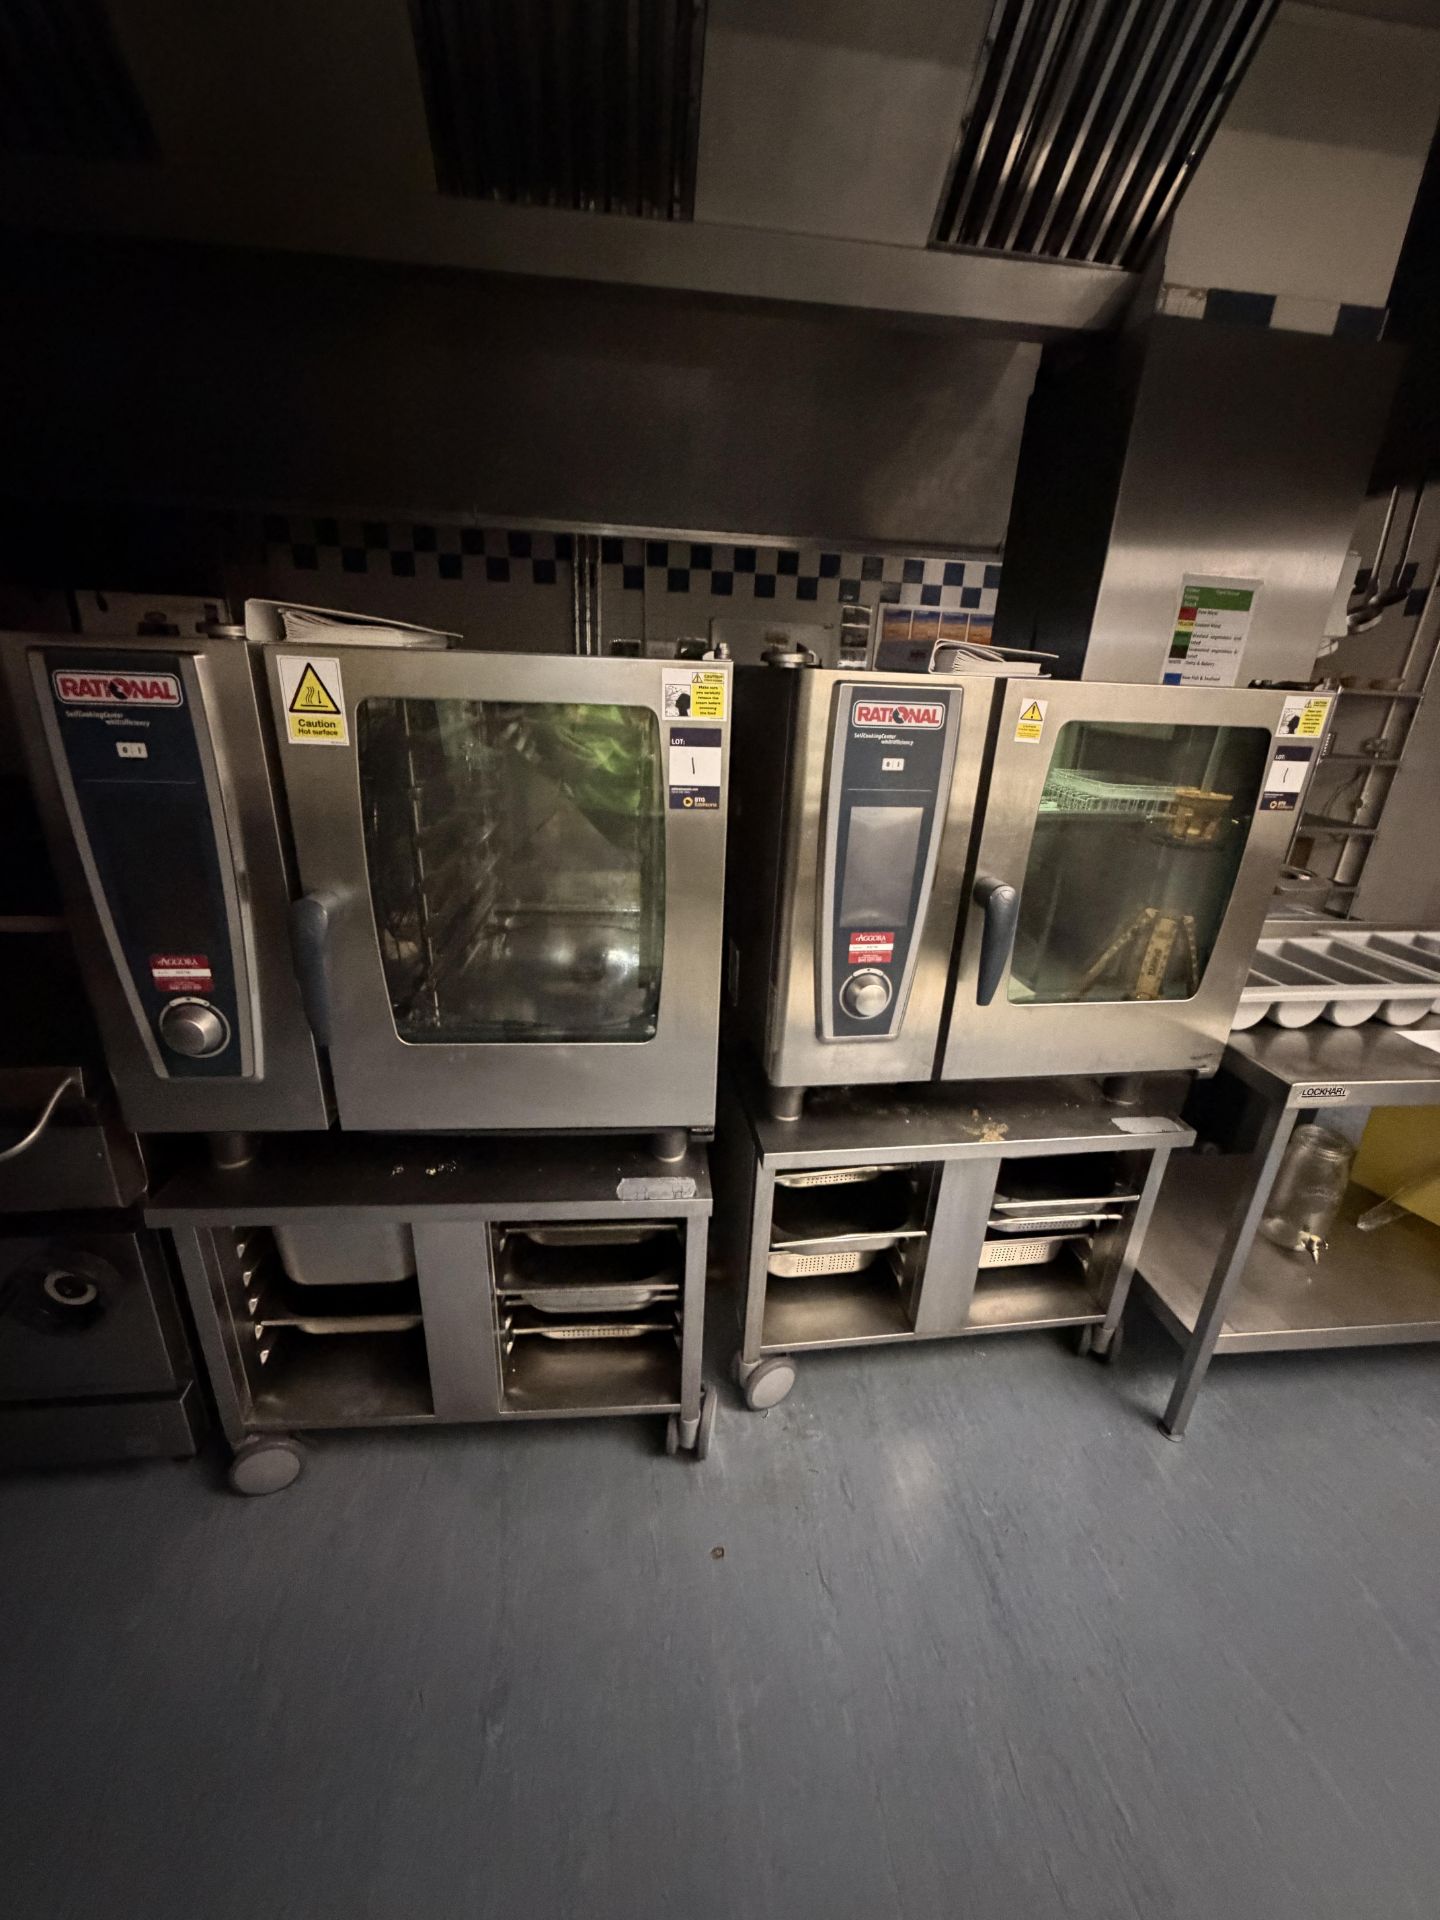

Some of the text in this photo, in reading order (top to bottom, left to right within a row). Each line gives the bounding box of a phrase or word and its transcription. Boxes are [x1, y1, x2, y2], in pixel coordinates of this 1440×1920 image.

[60, 677, 177, 700] RATIONAL
[298, 718, 336, 728] Caution
[857, 706, 939, 724] RATIONAL
